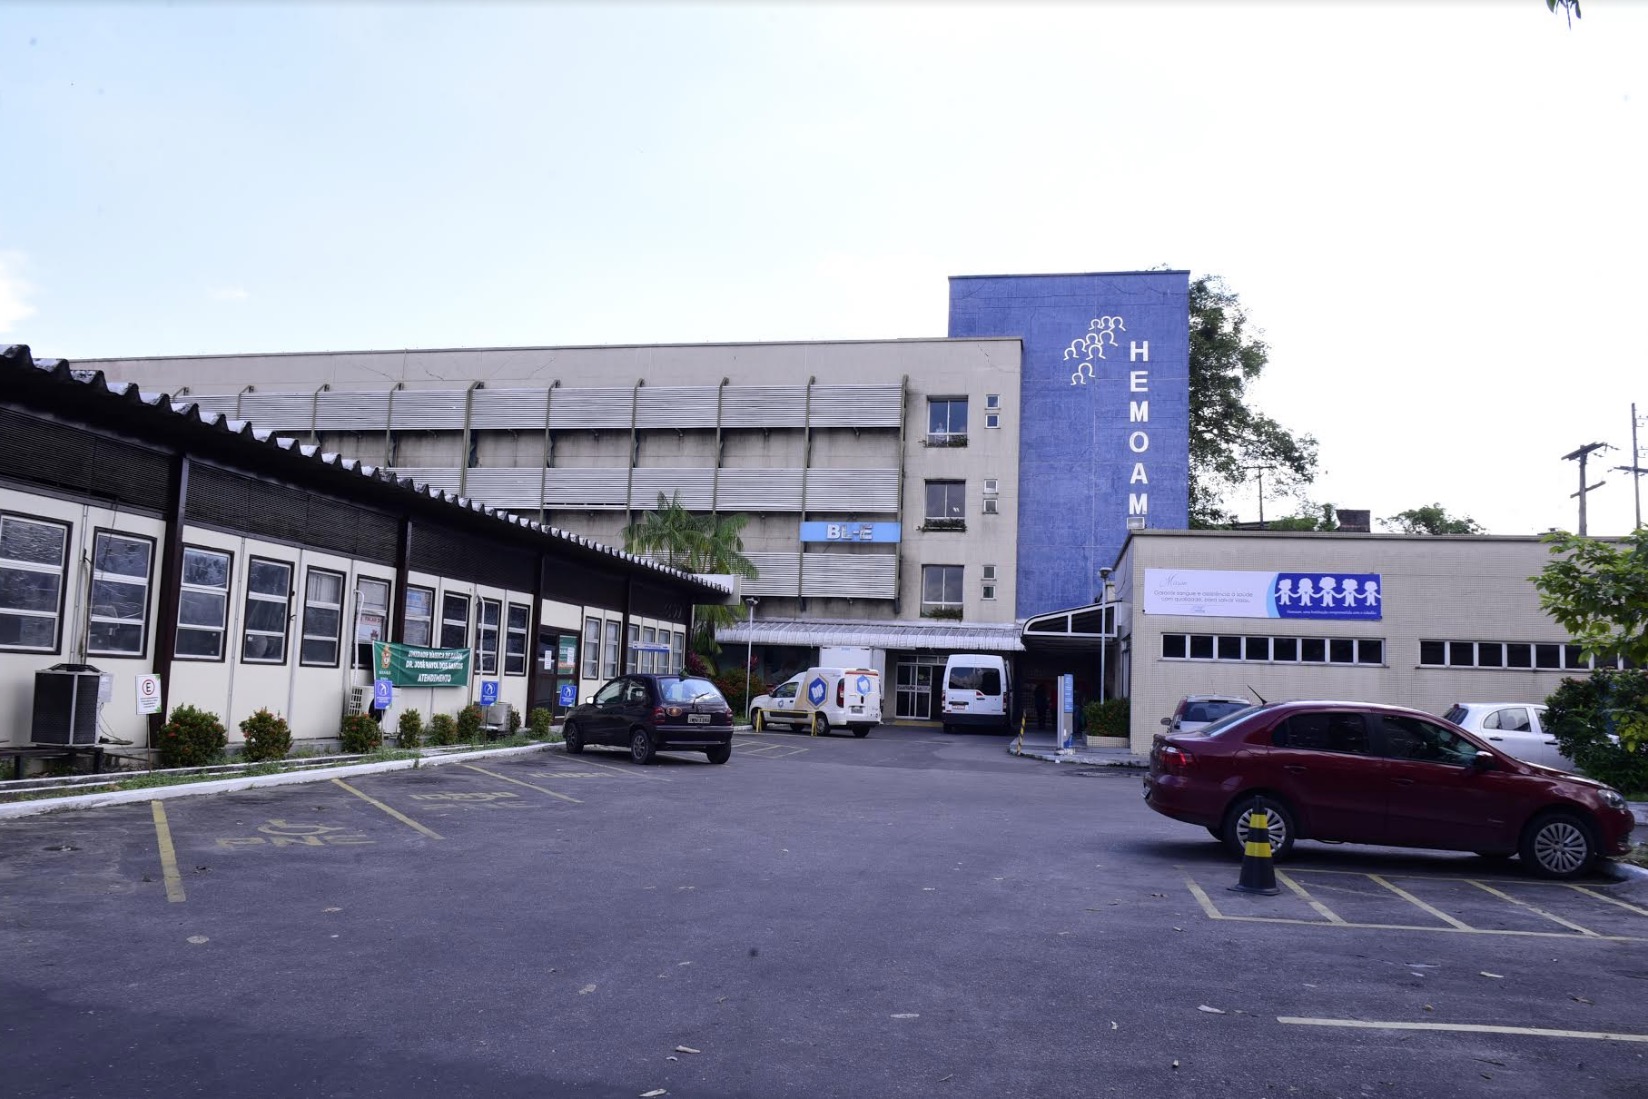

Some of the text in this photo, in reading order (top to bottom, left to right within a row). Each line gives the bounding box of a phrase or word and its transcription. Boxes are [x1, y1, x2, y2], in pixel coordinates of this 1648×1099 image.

[1128, 340, 1149, 515] HEMOAM
[417, 673, 452, 683] ATENDIMENTO
[146, 682, 151, 693] E
[215, 834, 376, 848] PNE
